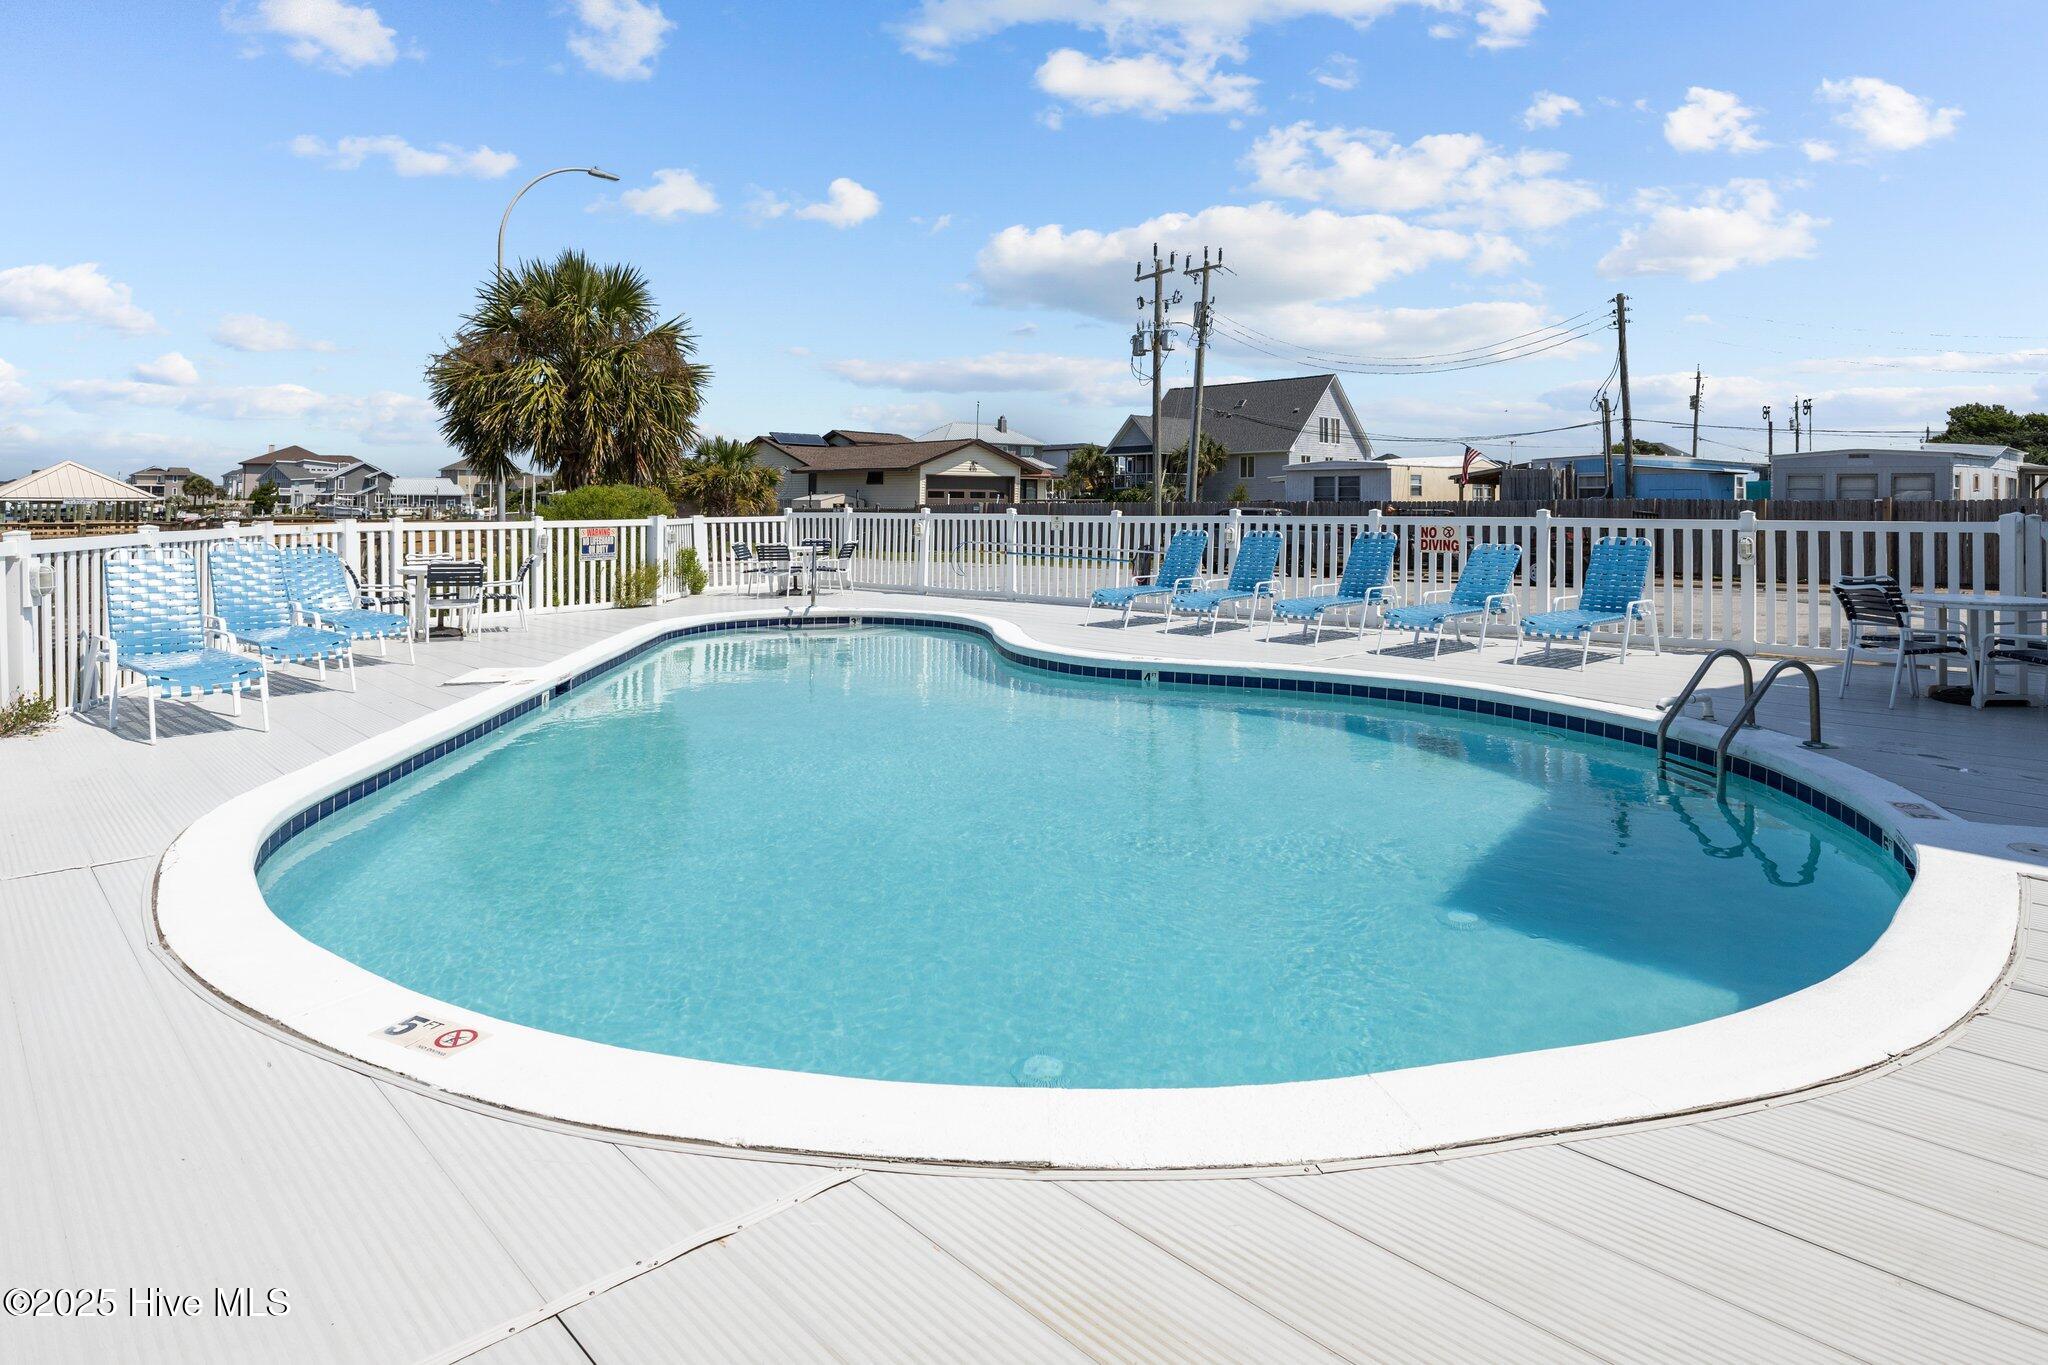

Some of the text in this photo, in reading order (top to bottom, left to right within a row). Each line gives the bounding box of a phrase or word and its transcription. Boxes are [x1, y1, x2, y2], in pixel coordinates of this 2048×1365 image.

[587, 528, 610, 537] WARNING
[1421, 527, 1437, 538] NO
[1421, 540, 1459, 551] DIVING
[384, 1015, 445, 1036] 5 FT
